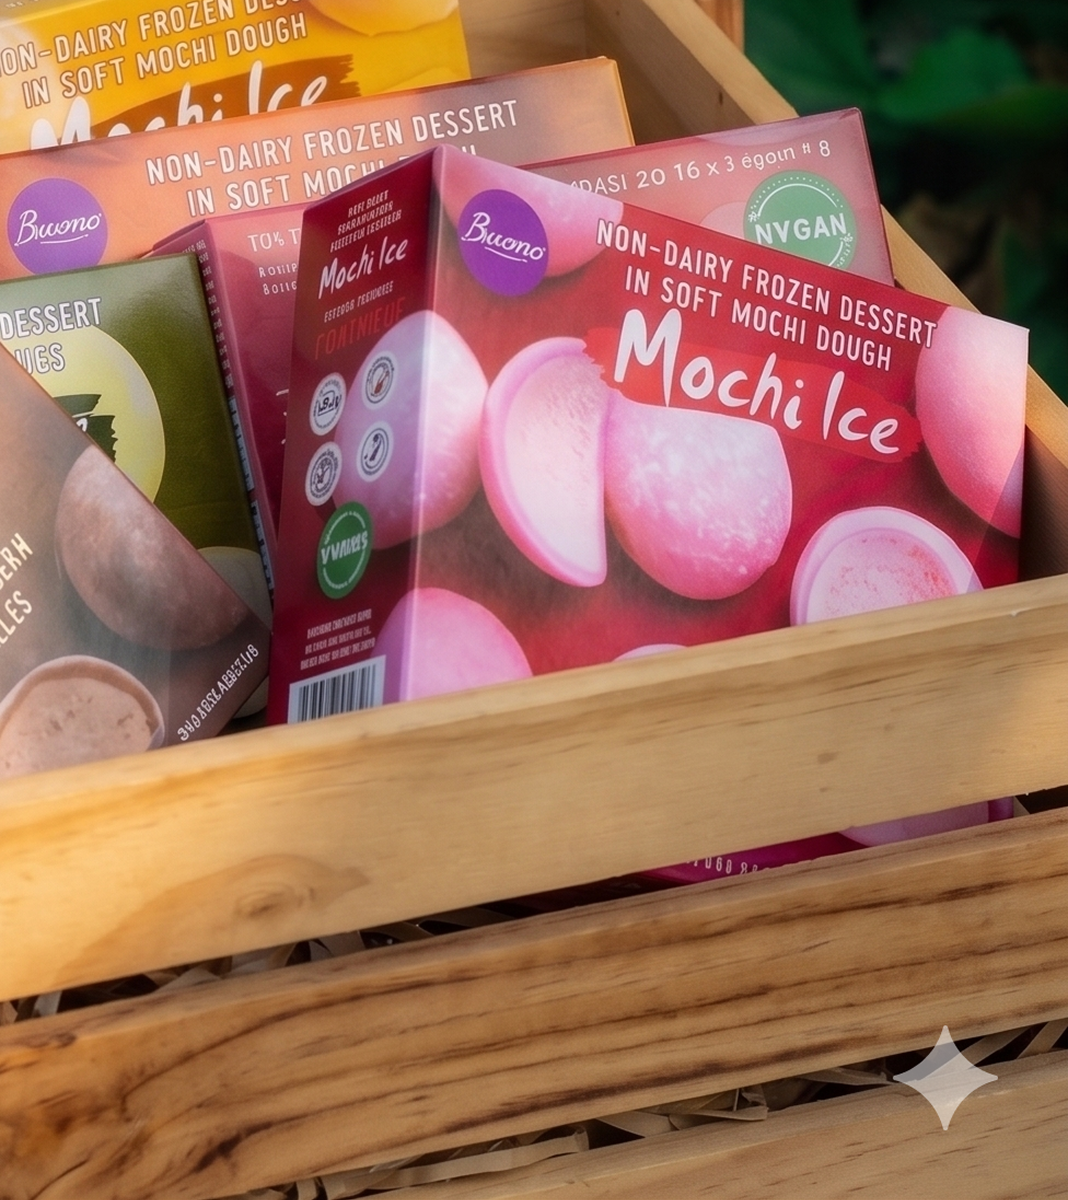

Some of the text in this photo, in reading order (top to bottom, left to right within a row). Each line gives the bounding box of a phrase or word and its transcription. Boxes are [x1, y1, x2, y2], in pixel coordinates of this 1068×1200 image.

[22, 12, 309, 109] IN SOFT MOCHI DOUGH
[145, 99, 518, 186] NON-DAIRY FROZEN DESSERT
[636, 168, 666, 189] 20
[673, 160, 700, 181] 16
[724, 155, 735, 172] 3
[819, 140, 831, 157] 8
[186, 188, 215, 217] IN
[225, 173, 292, 211] SOFT
[754, 212, 848, 246] NVGAN
[318, 236, 408, 299] Mochi Ice
[596, 218, 938, 349] NON-DAIRY FROZEN DESSERT
[0, 298, 102, 340] DESSERT
[625, 265, 892, 371] IN SOFT MOCHI DOUGH
[613, 308, 900, 455] Mochi Ice
